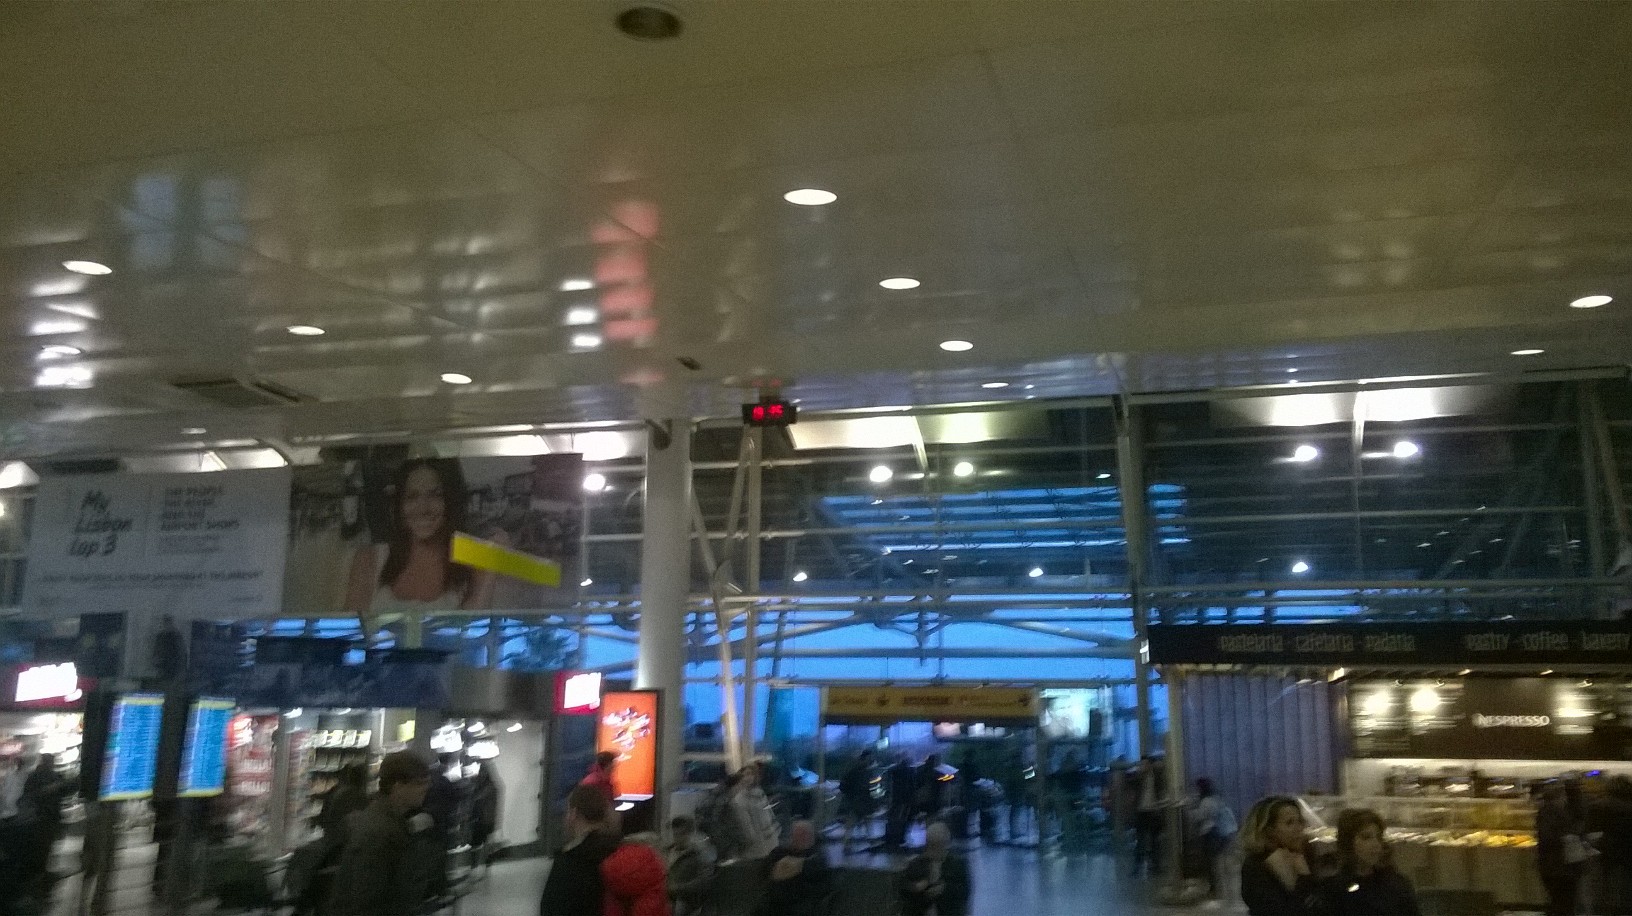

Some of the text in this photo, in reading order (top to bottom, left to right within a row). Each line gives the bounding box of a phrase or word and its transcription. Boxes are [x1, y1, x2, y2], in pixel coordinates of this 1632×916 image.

[81, 489, 112, 514] My
[74, 511, 133, 534] Lisbon
[102, 533, 118, 556] 3
[1521, 631, 1569, 651] coffee
[1476, 713, 1550, 728] NESPRESSO
